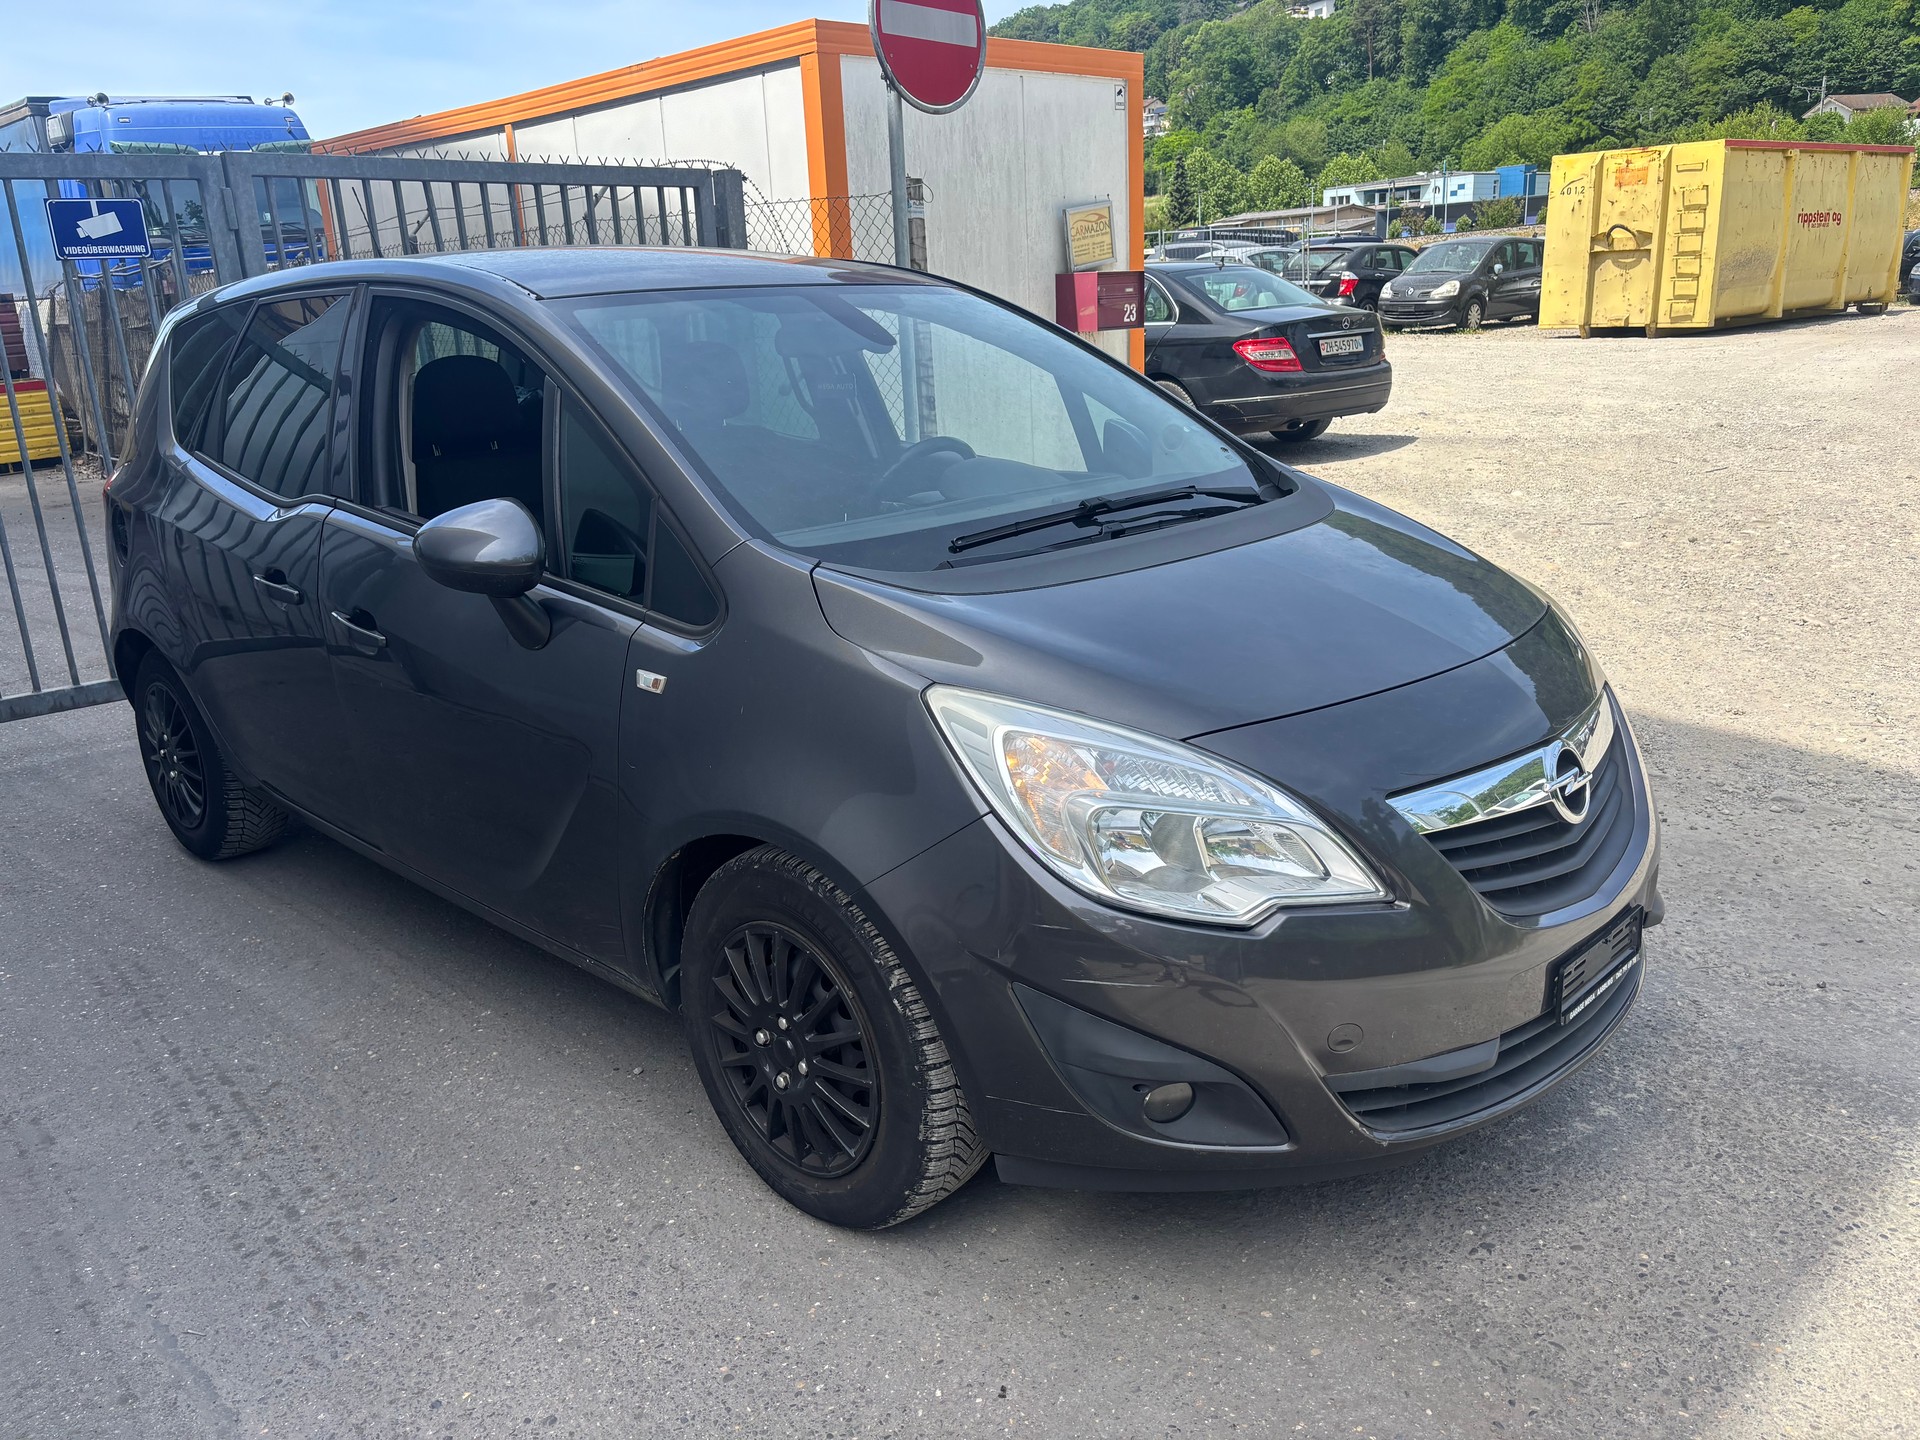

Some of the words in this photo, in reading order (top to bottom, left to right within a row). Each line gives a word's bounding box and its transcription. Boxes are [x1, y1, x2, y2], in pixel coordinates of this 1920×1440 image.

[1071, 220, 1110, 238] CARMAZON
[1797, 208, 1830, 231] rippstein
[1832, 211, 1842, 226] ag
[63, 244, 146, 255] VIDEOÜBERWACHUNG
[1123, 303, 1137, 323] 23
